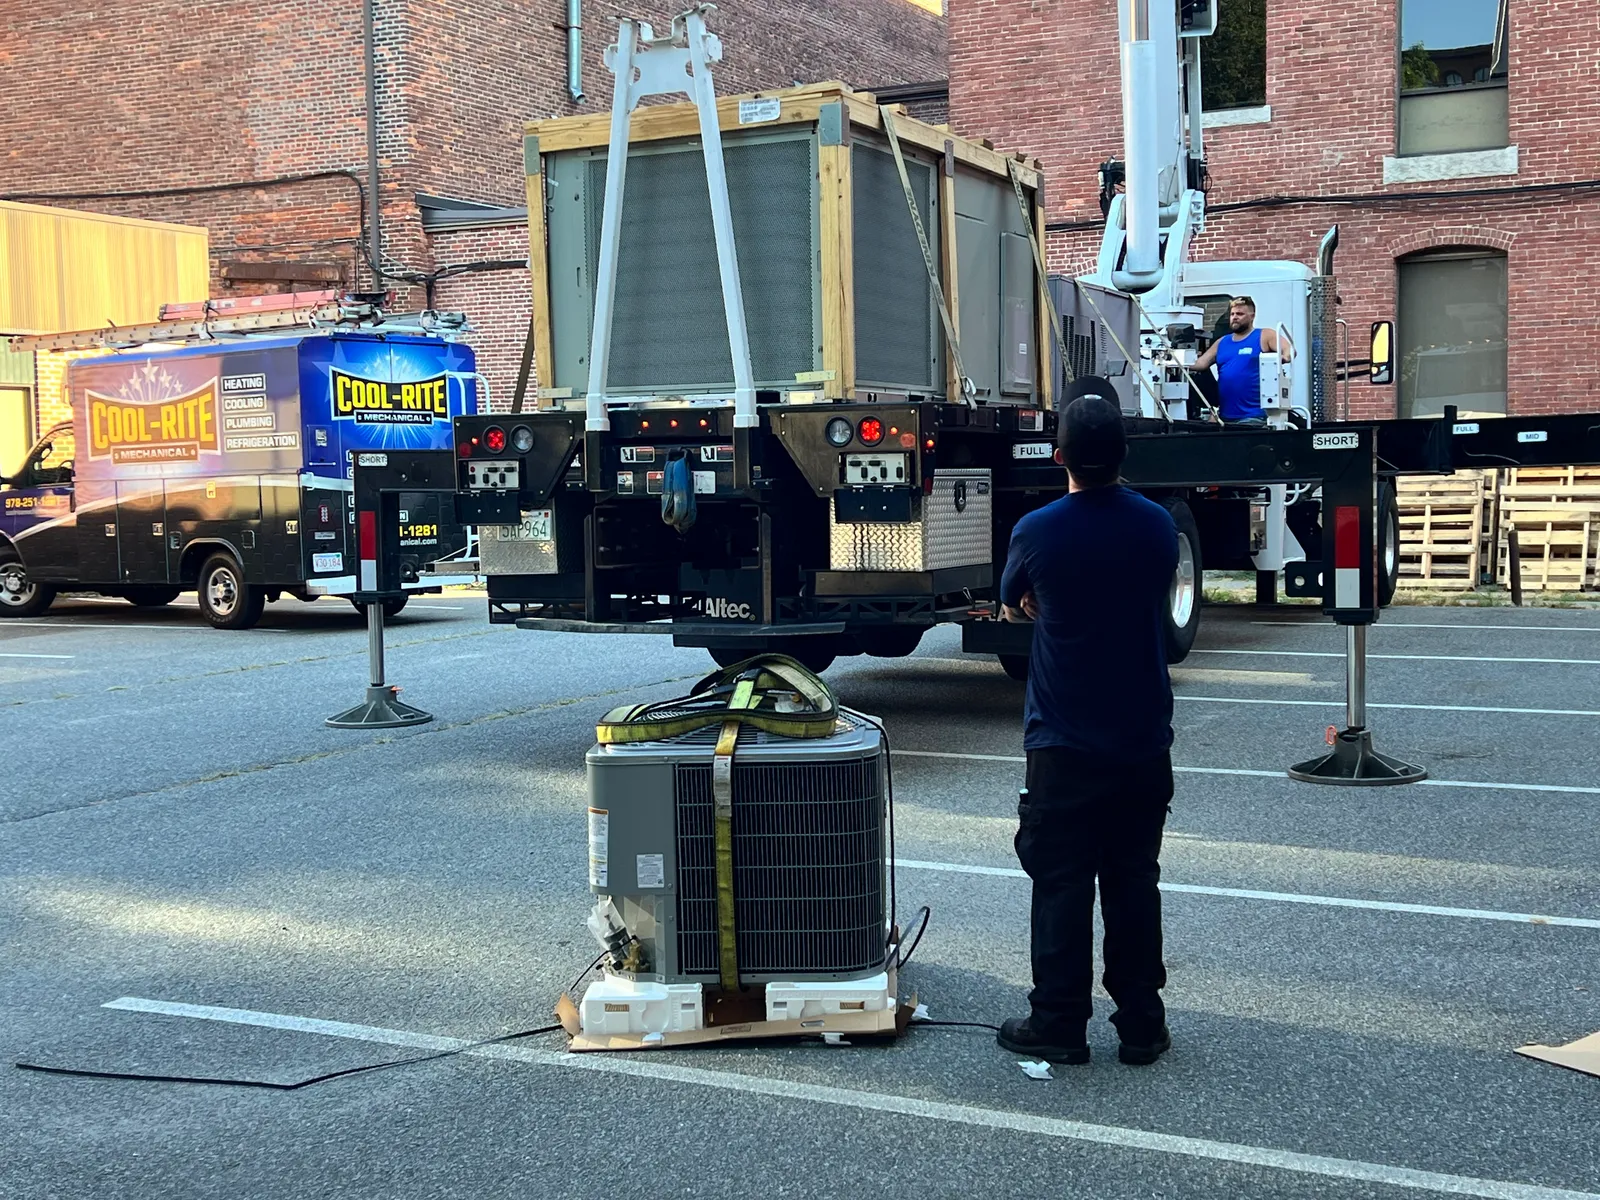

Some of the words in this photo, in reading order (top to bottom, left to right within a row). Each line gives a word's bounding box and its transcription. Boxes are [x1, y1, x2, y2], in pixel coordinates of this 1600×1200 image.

[223, 376, 263, 390] HEATING
[336, 375, 446, 413] COOL-RITE
[224, 397, 264, 410] COOLING
[92, 391, 215, 449] COOL-RITE
[226, 416, 273, 429] PLUMBING
[364, 413, 425, 422] MECHANICAL
[226, 435, 296, 449] REFRIGERATION
[1316, 436, 1356, 446] SHORT
[120, 447, 189, 460] MECHANICAL
[1020, 447, 1045, 456] FULL
[360, 455, 386, 464] SHORT
[399, 524, 438, 537] 1-1281
[400, 538, 438, 546] anical.com
[705, 597, 750, 618] Altec
